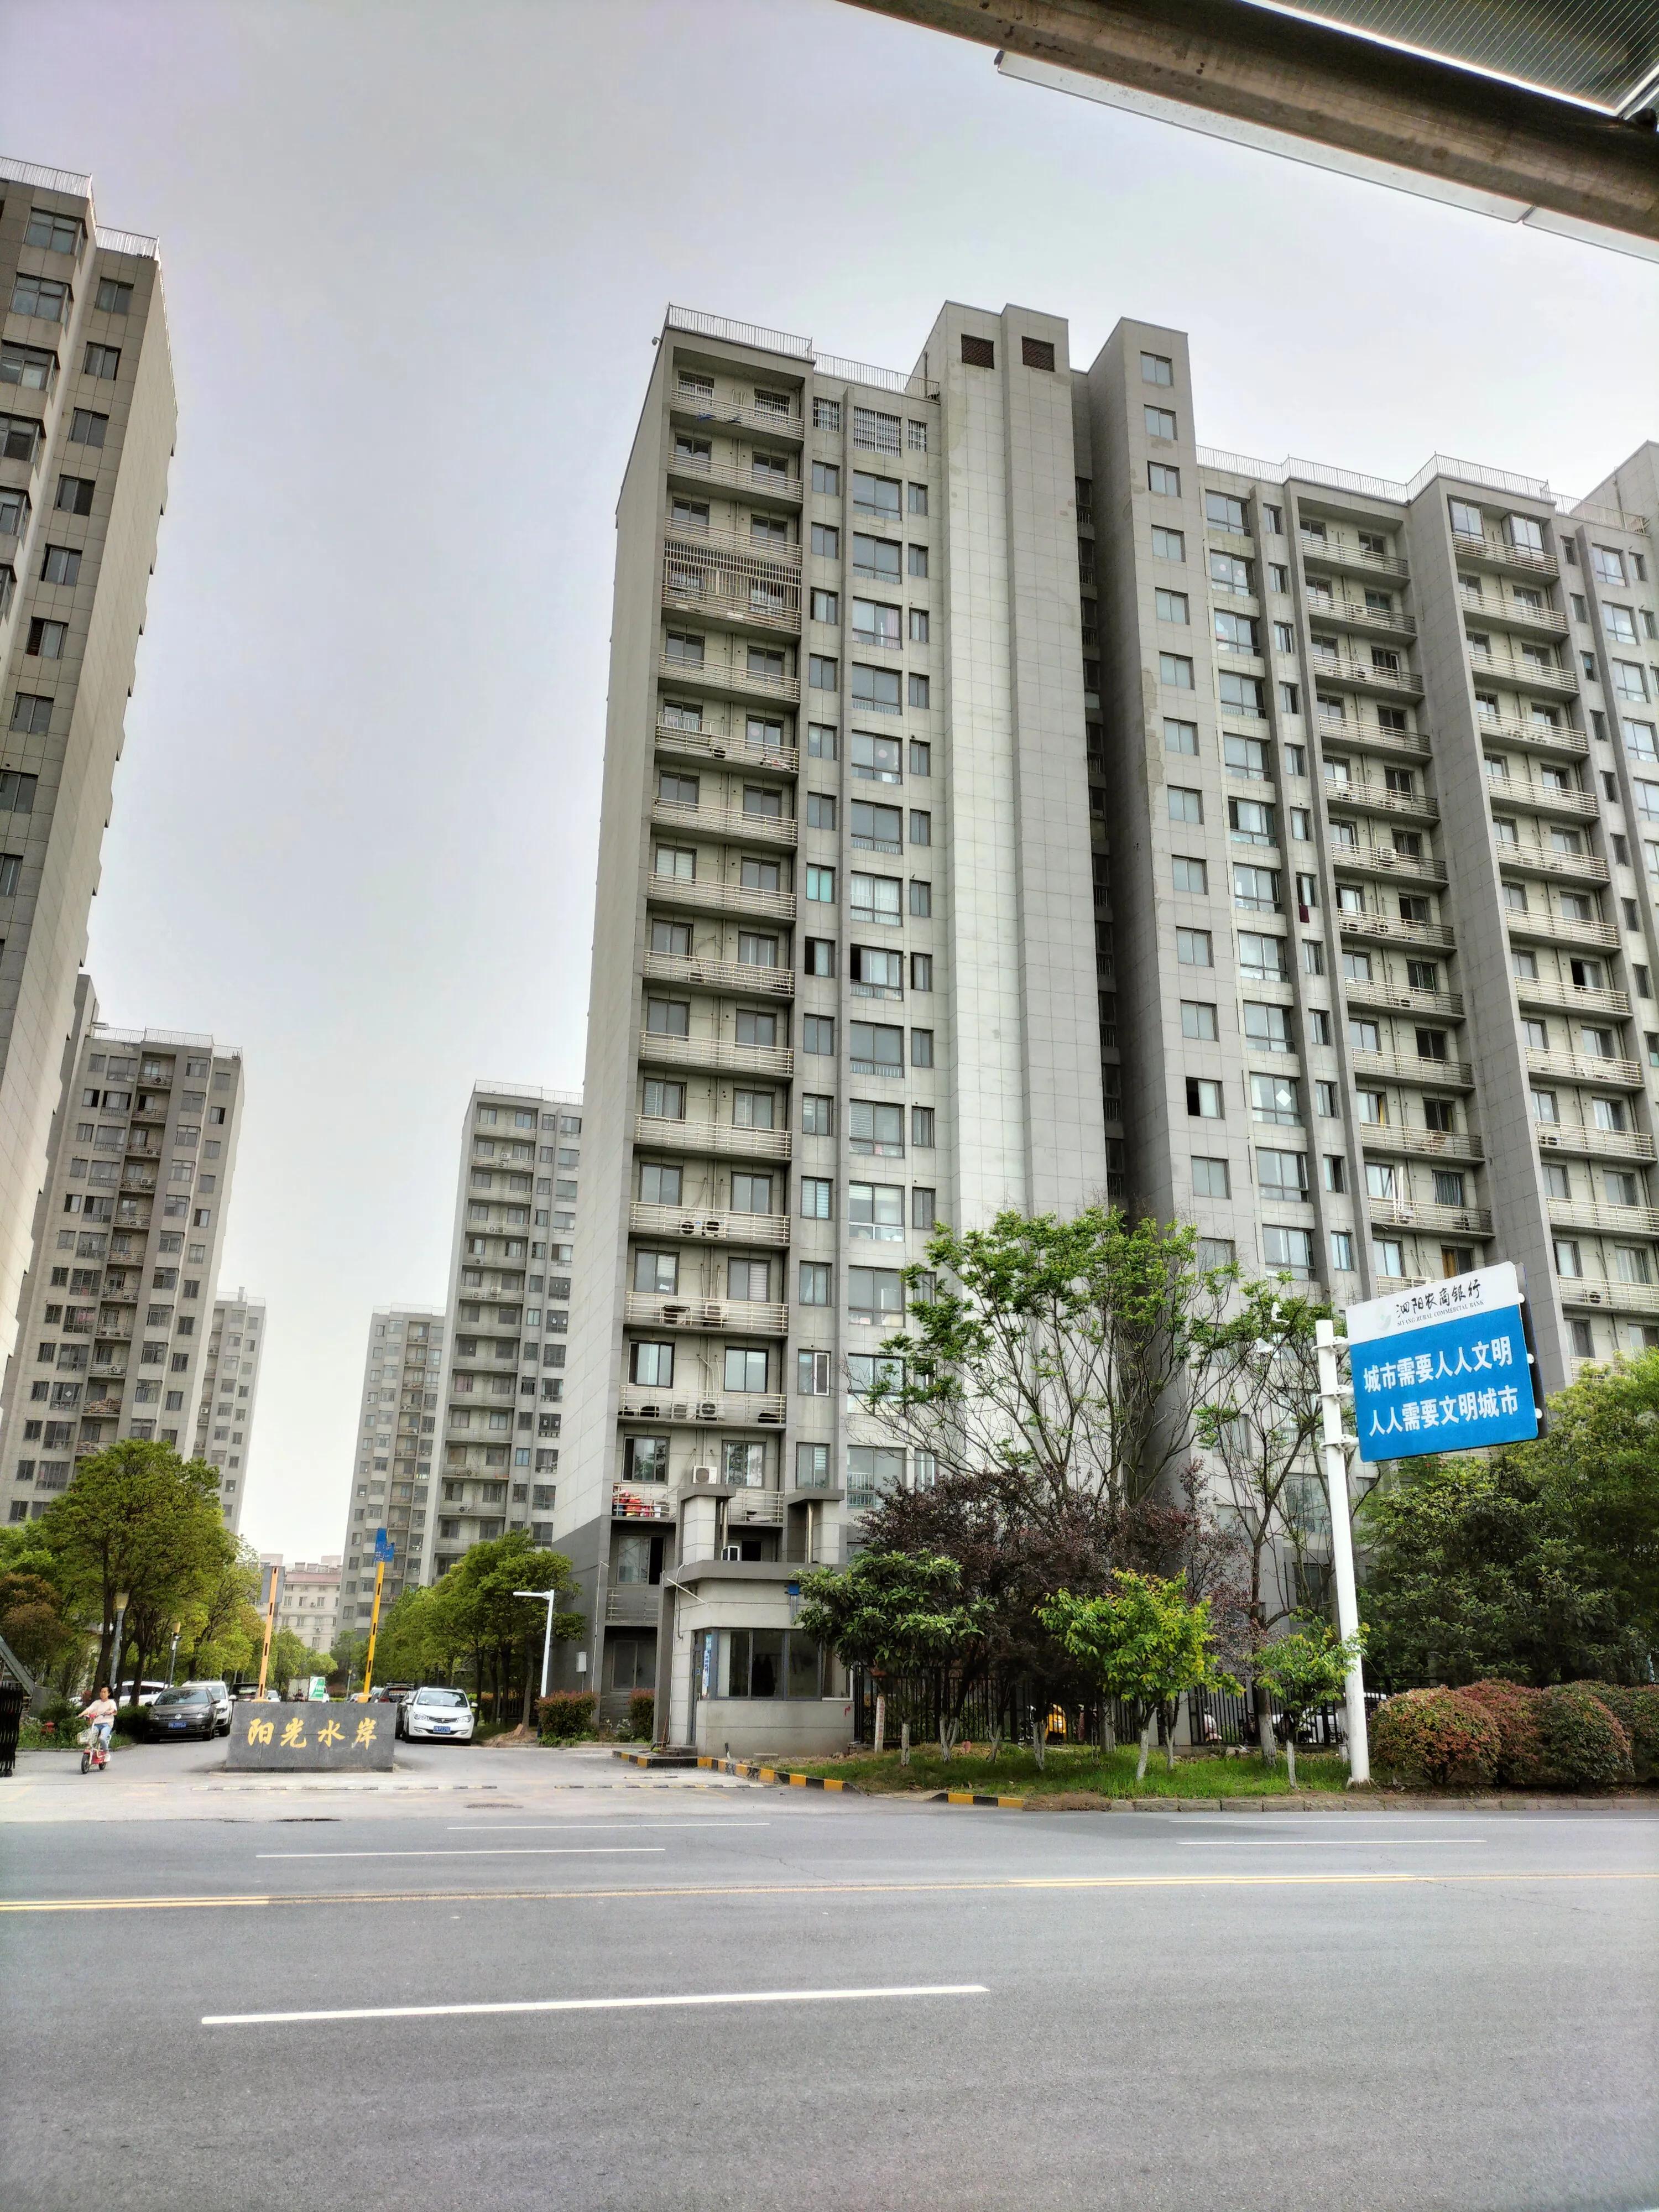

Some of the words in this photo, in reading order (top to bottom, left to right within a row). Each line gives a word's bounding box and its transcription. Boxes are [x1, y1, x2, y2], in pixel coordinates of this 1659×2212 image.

[1396, 1279, 1481, 1318] 泗阳农商银行
[1397, 1318, 1415, 1327] SIYANG
[1434, 1305, 1468, 1317] COMMERCIAL
[1363, 1335, 1512, 1393] 城市需要人人文明
[1369, 1385, 1518, 1437] 人人需要文明城市
[248, 1717, 377, 1750] 阳光水岸
